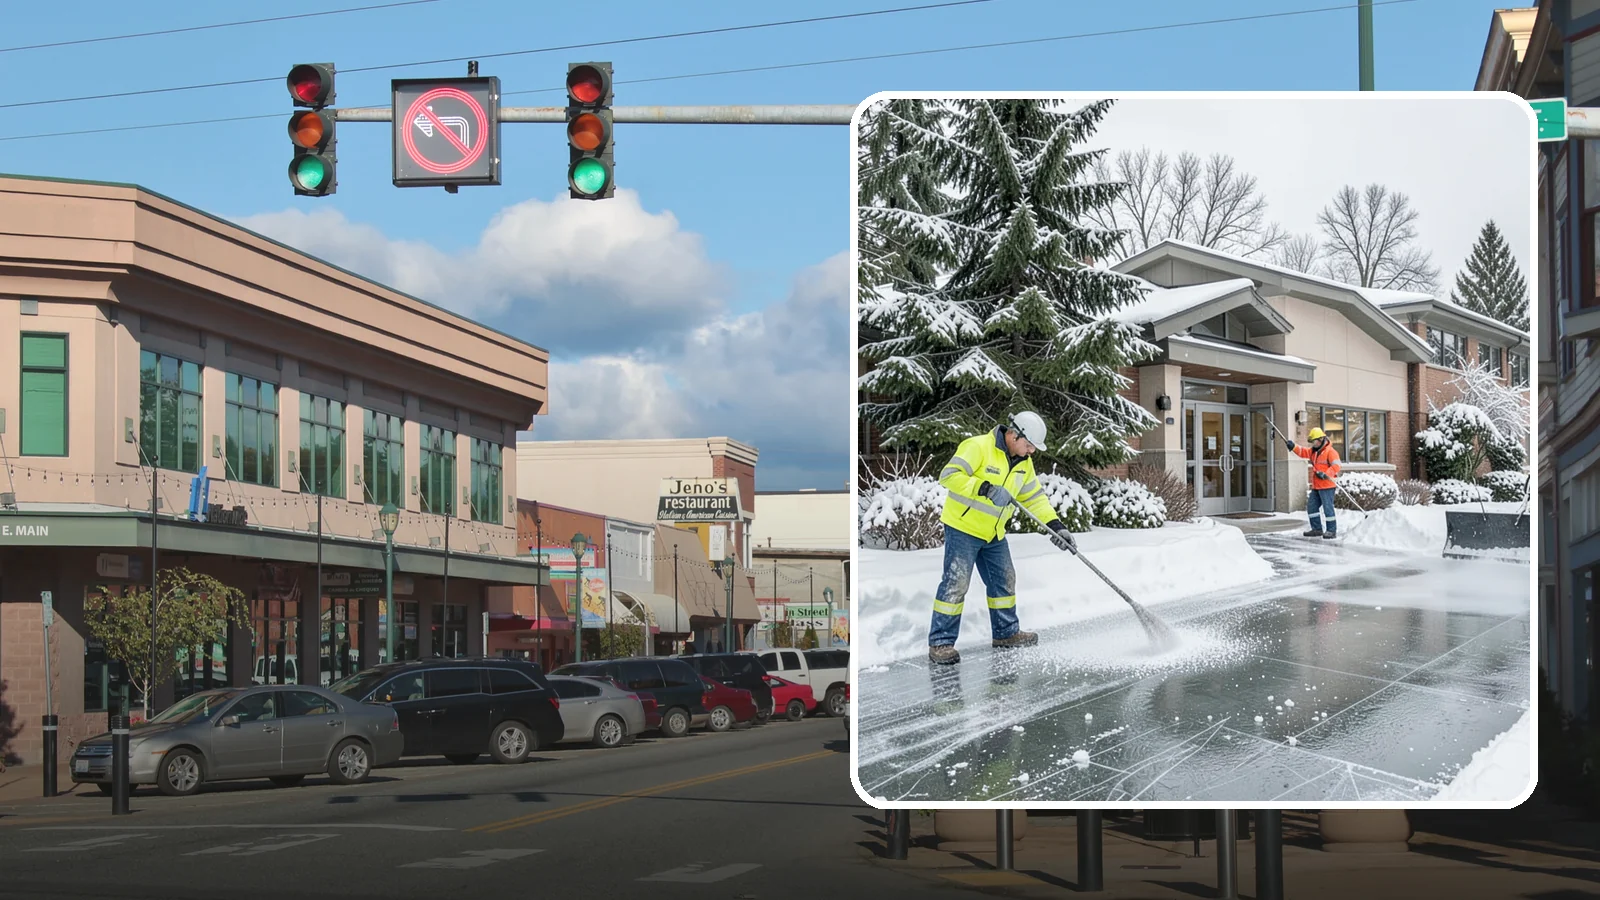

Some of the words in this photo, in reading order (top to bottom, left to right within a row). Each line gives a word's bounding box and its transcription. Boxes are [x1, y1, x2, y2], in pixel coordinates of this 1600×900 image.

[669, 480, 728, 494] Jeno's
[664, 496, 731, 509] restaurant
[658, 509, 681, 519] Italian
[686, 509, 714, 519] American
[715, 509, 738, 519] Cuisine
[2, 525, 13, 536] E.
[15, 525, 49, 536] MAIN
[797, 607, 829, 617] Street
